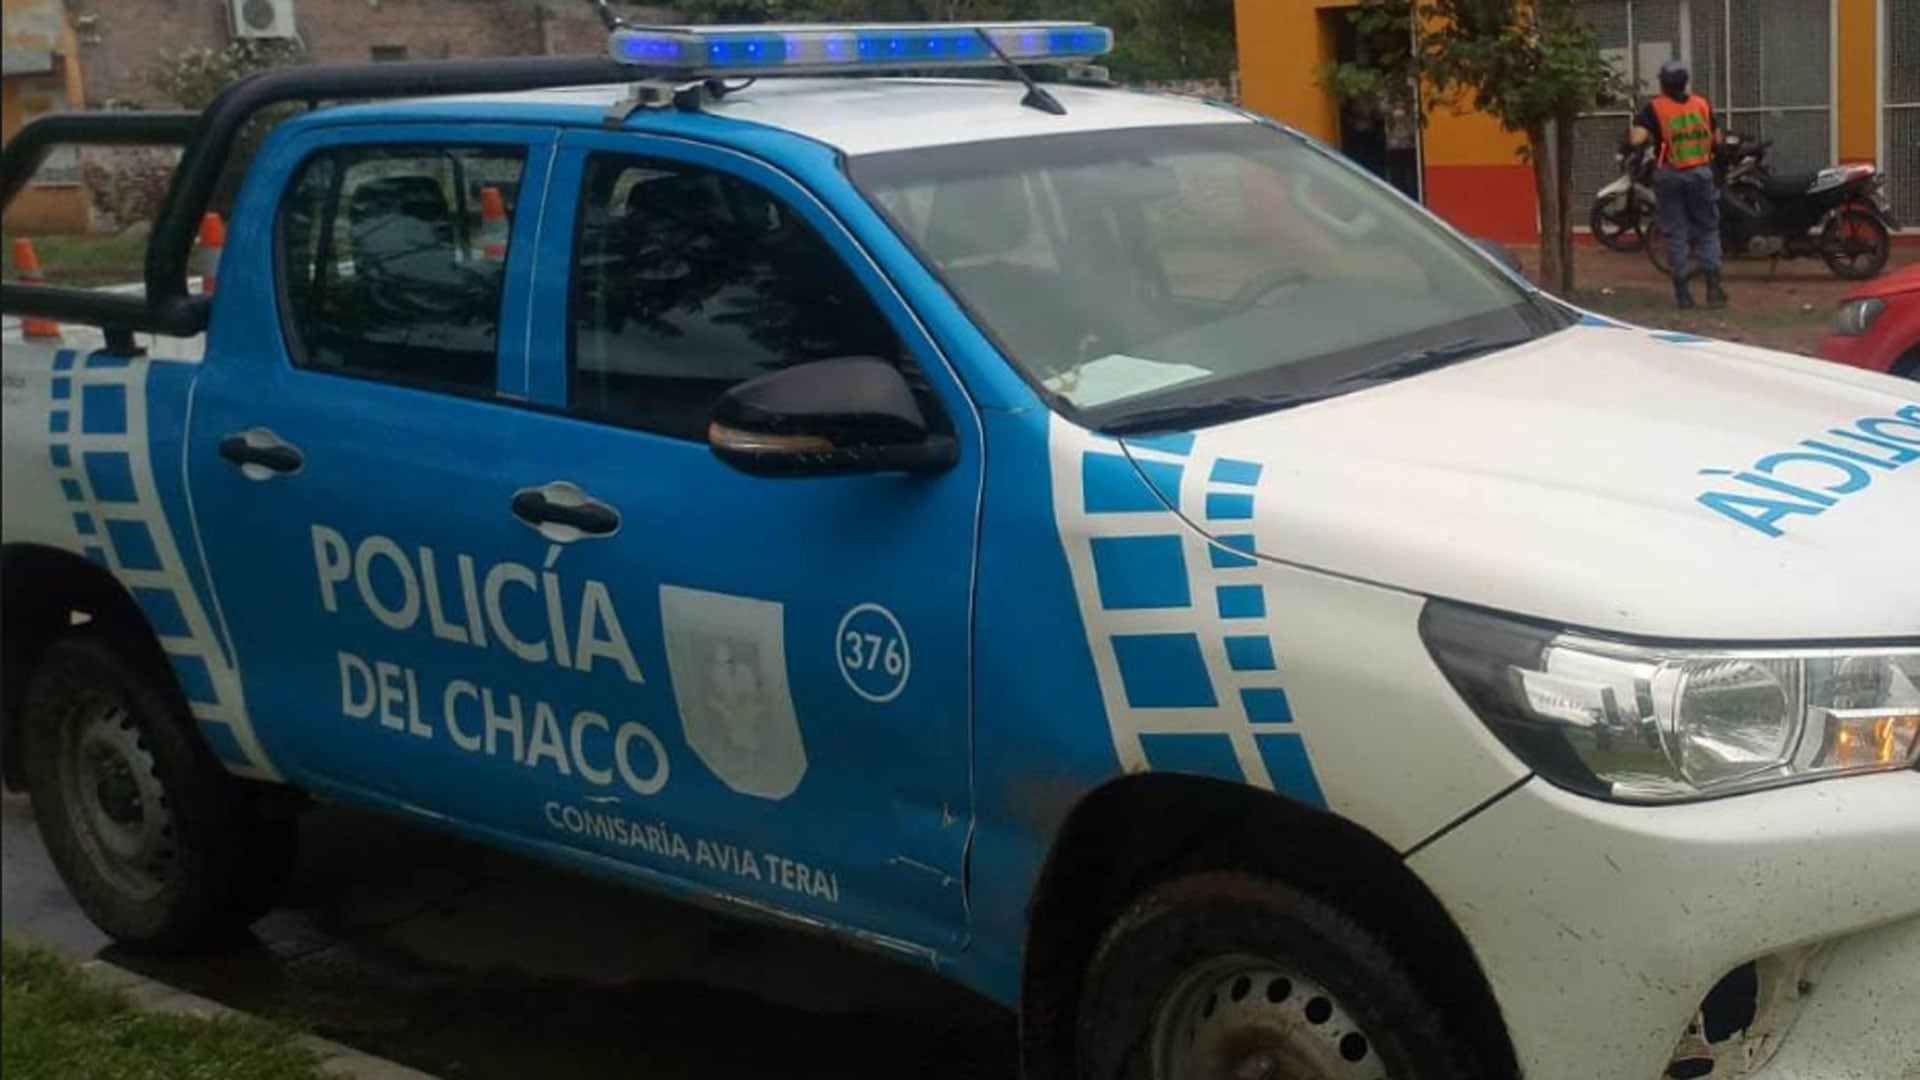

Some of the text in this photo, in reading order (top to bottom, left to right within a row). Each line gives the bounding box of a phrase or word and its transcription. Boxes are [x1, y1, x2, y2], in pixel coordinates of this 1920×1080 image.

[311, 524, 645, 684] POLICÍA
[845, 630, 902, 675] 376
[338, 651, 671, 796] DEL CHACO
[545, 800, 840, 902] COMISARÍA AVIA TERAI
